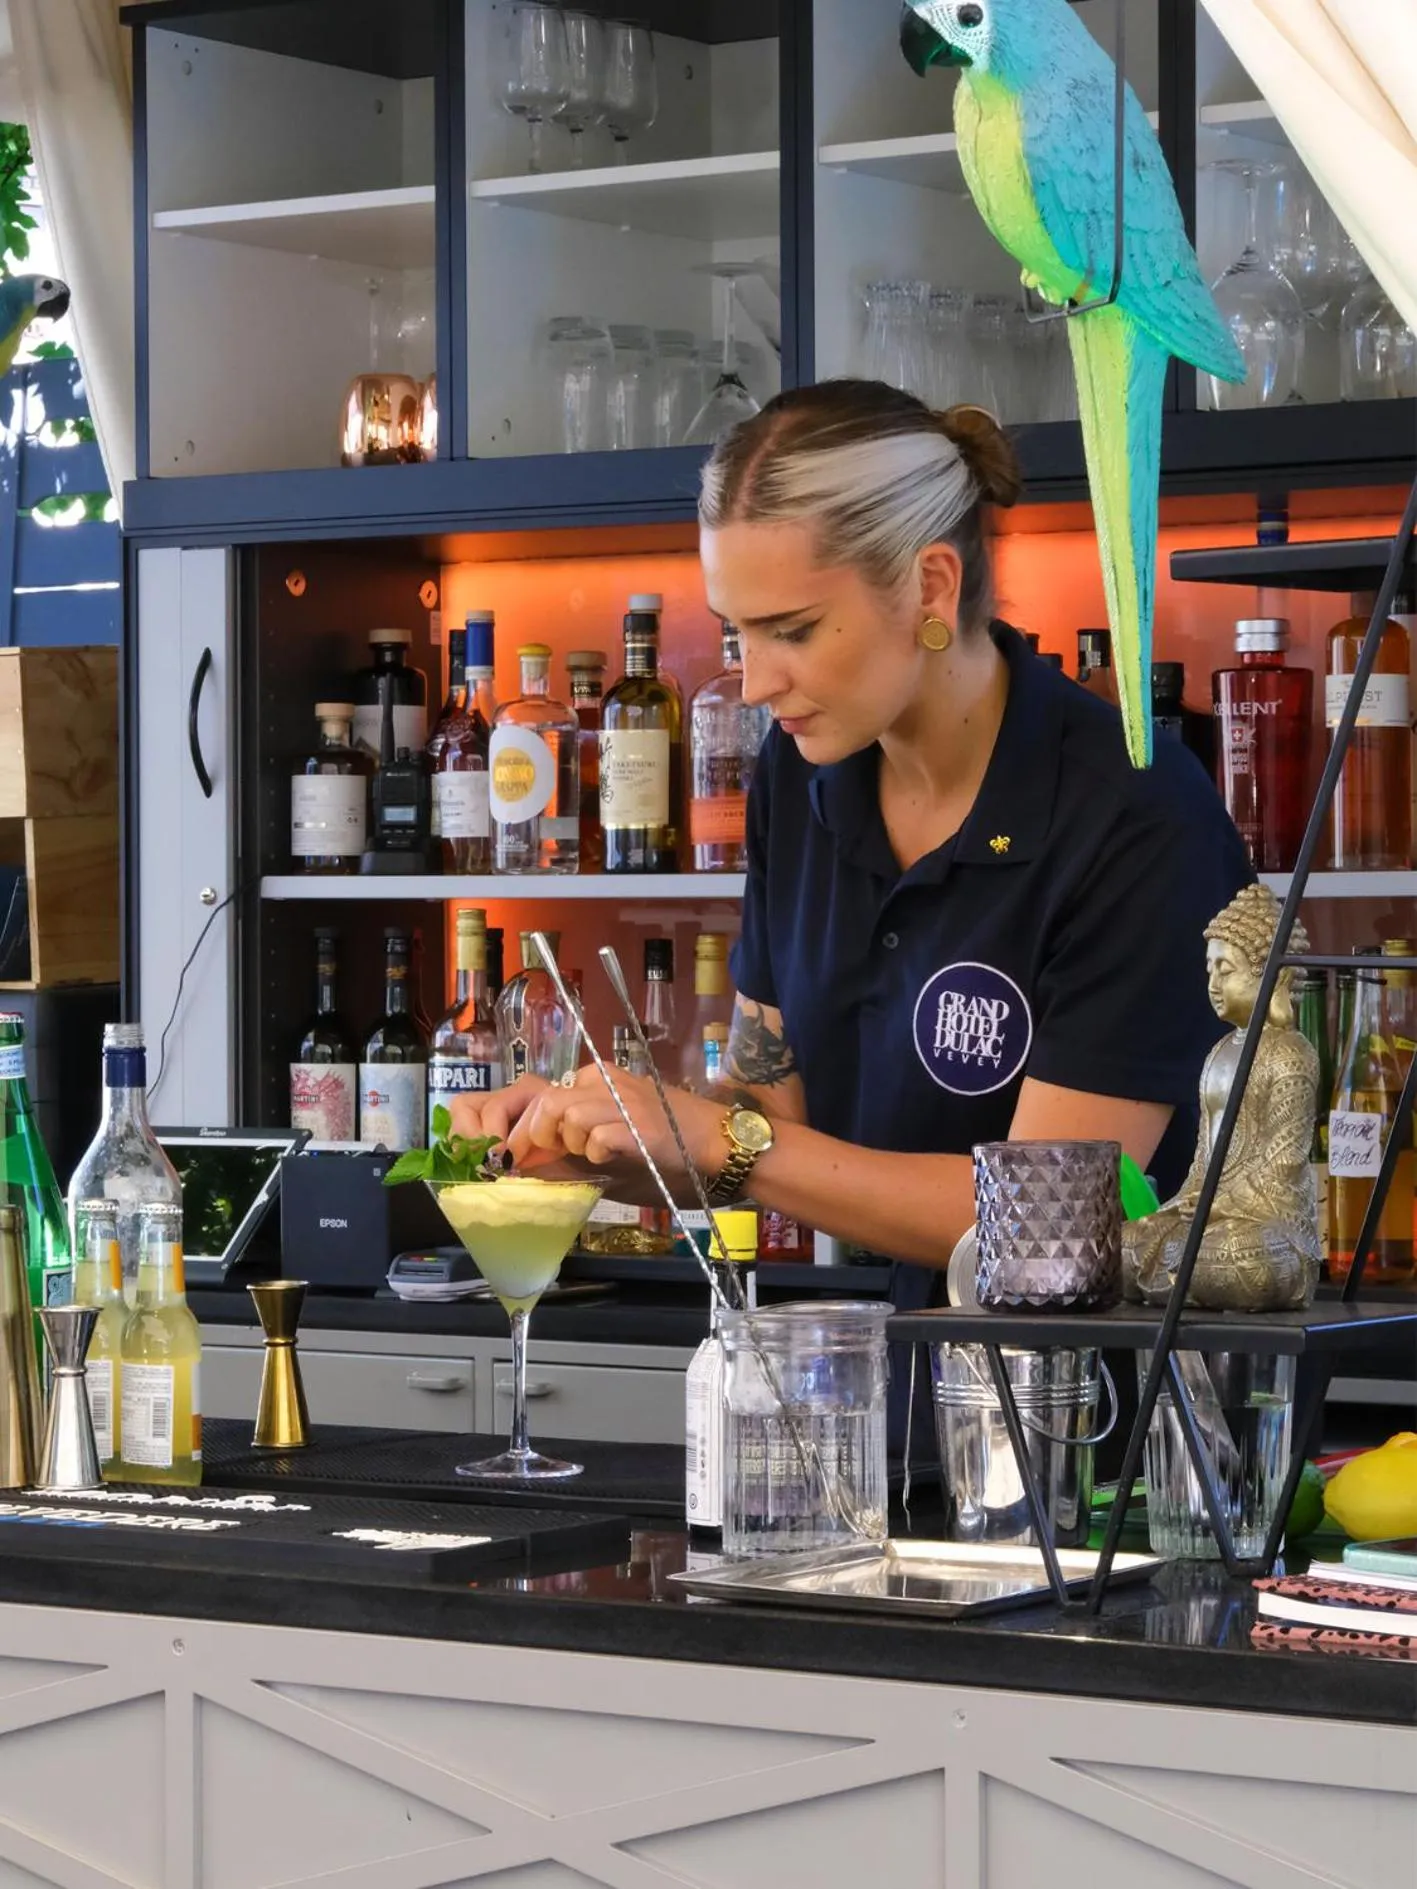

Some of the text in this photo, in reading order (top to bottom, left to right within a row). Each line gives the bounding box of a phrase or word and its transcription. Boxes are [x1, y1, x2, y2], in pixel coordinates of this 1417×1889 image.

[938, 990, 1010, 1022] GRAND
[936, 1008, 1006, 1039] HOTEL
[933, 1048, 1001, 1069] VEVEY
[319, 1218, 348, 1229] EPSON
